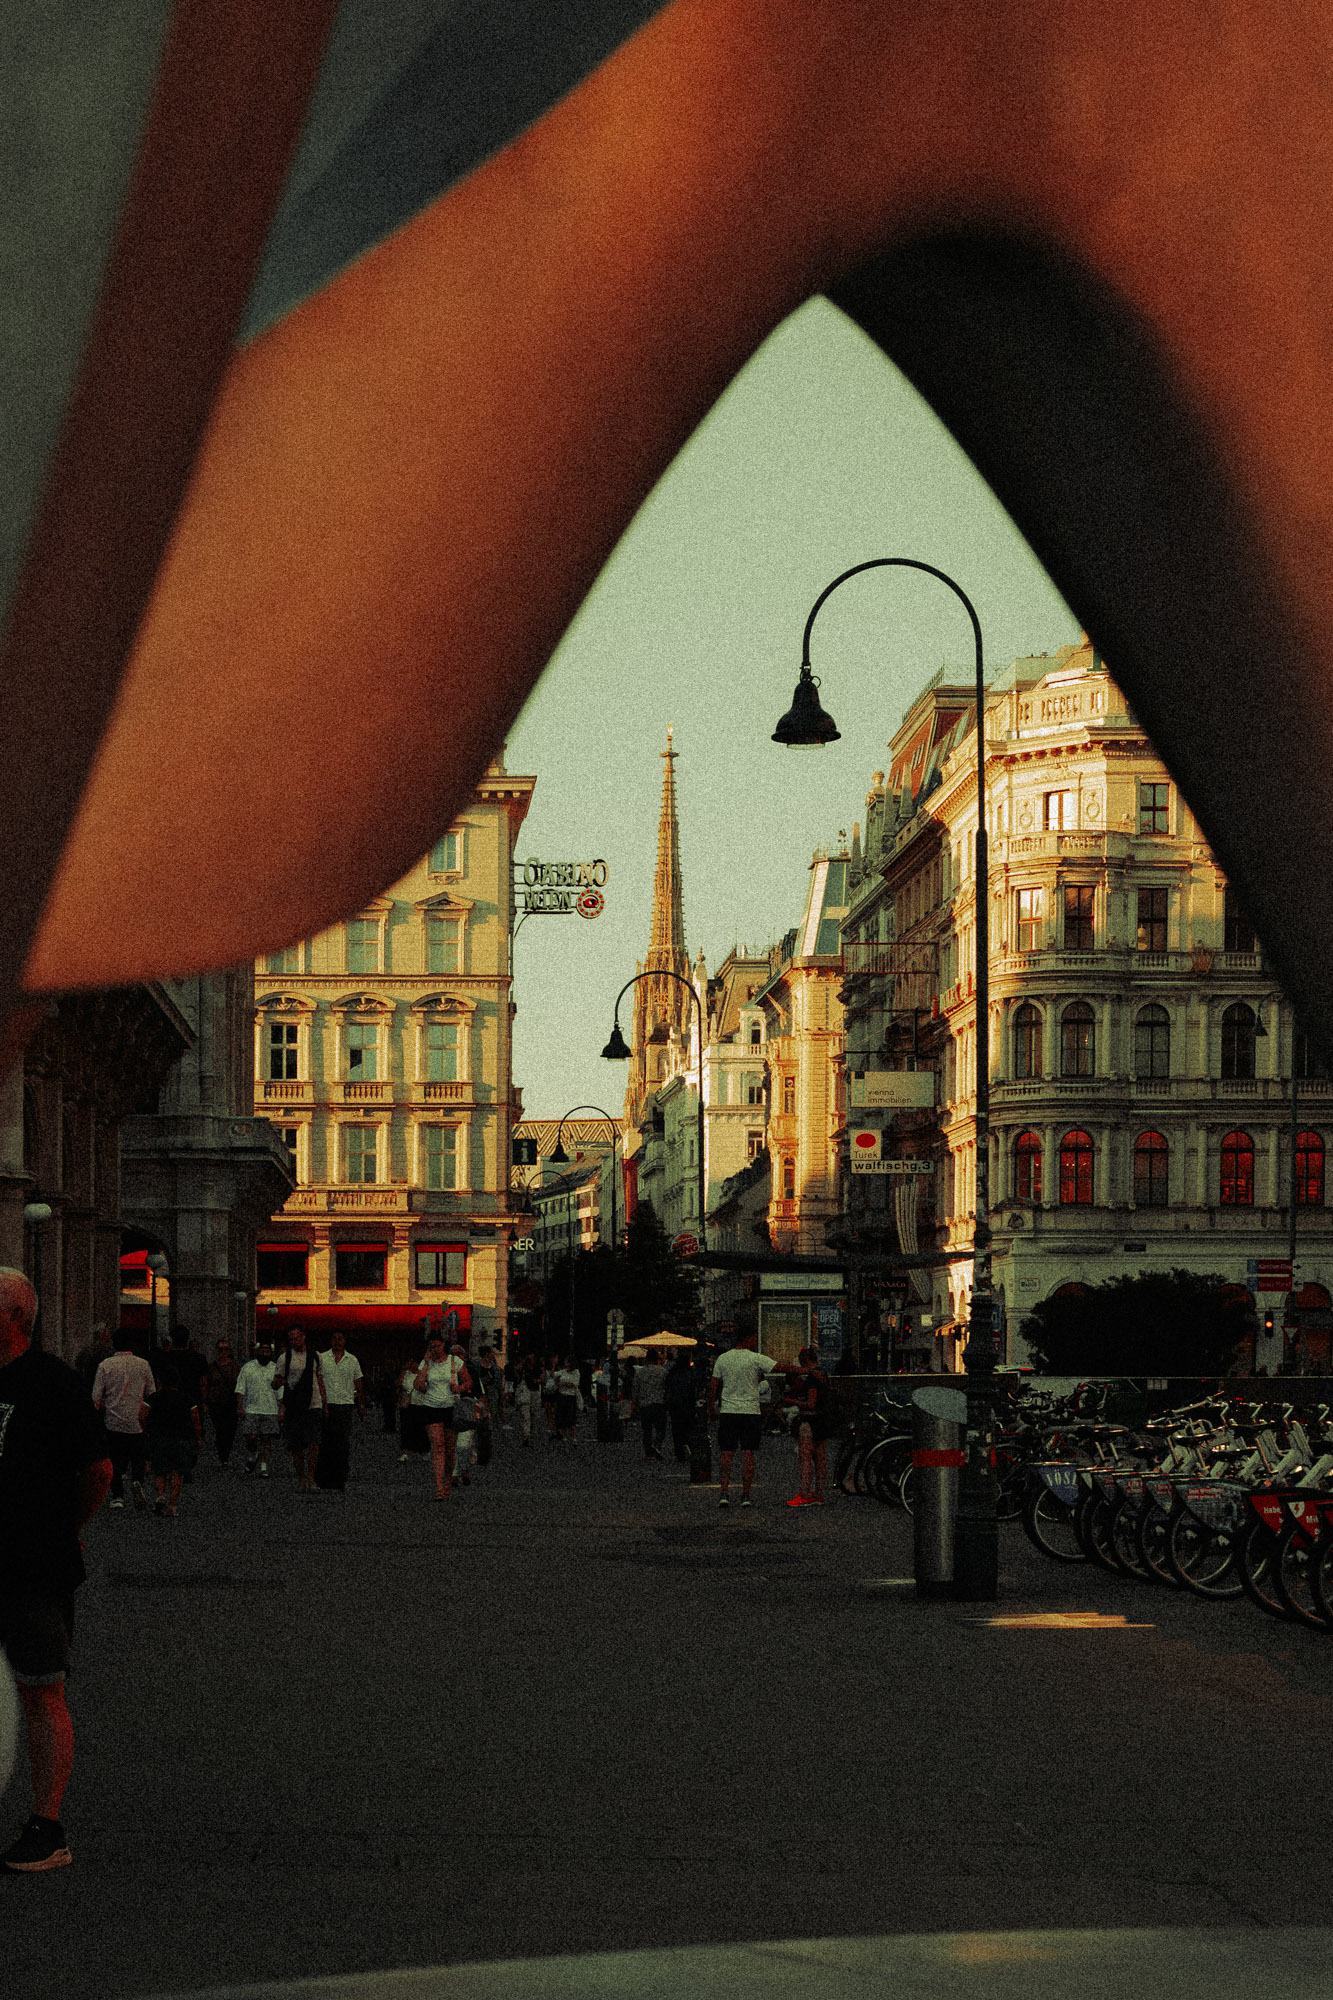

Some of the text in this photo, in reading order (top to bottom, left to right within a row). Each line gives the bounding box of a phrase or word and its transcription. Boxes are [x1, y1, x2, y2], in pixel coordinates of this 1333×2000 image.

[523, 857, 610, 887] CASINO
[524, 890, 574, 911] WIEN
[868, 1088, 895, 1096] vienna
[853, 1150, 878, 1159] Turek
